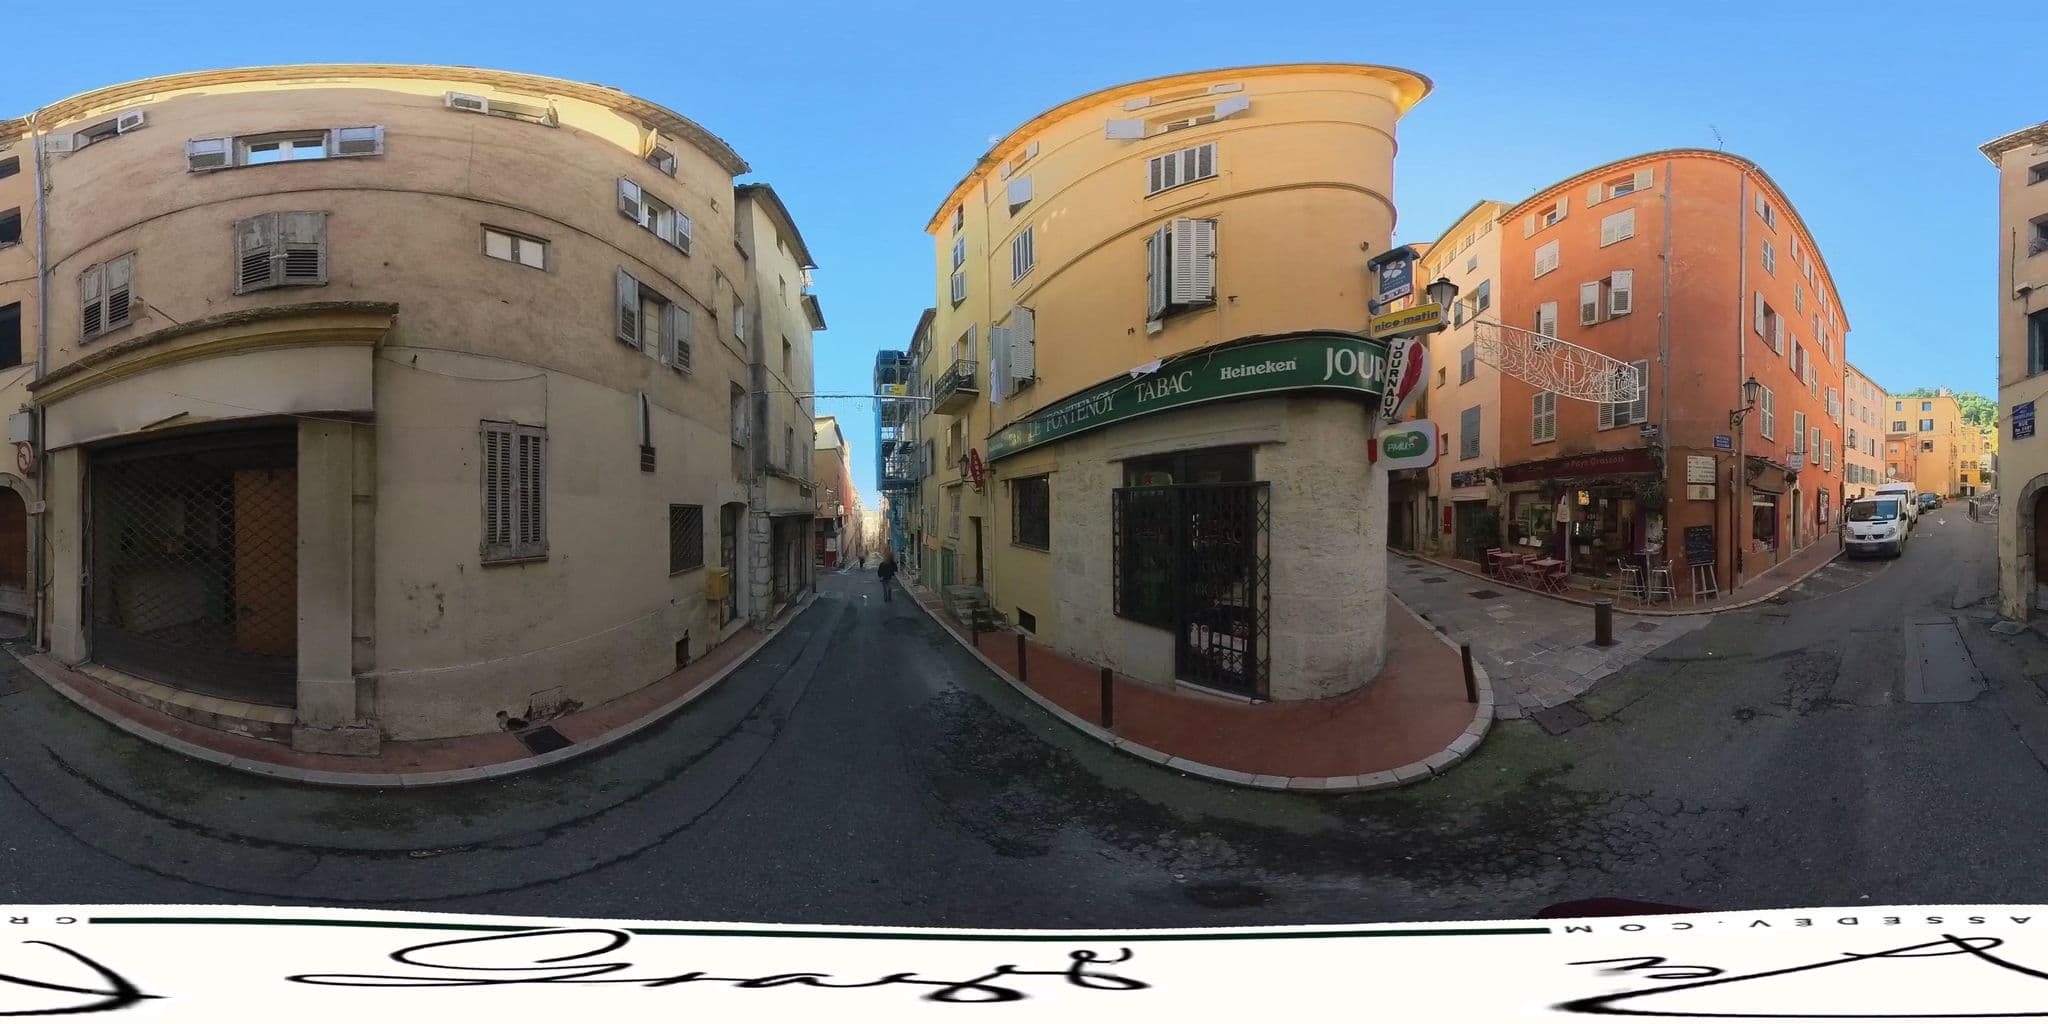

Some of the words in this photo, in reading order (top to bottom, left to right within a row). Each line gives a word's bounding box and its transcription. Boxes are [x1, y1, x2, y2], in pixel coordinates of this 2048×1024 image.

[1220, 359, 1297, 380] Heineken
[1383, 342, 1404, 418] JOURNAUX
[1135, 371, 1193, 403] TABAC
